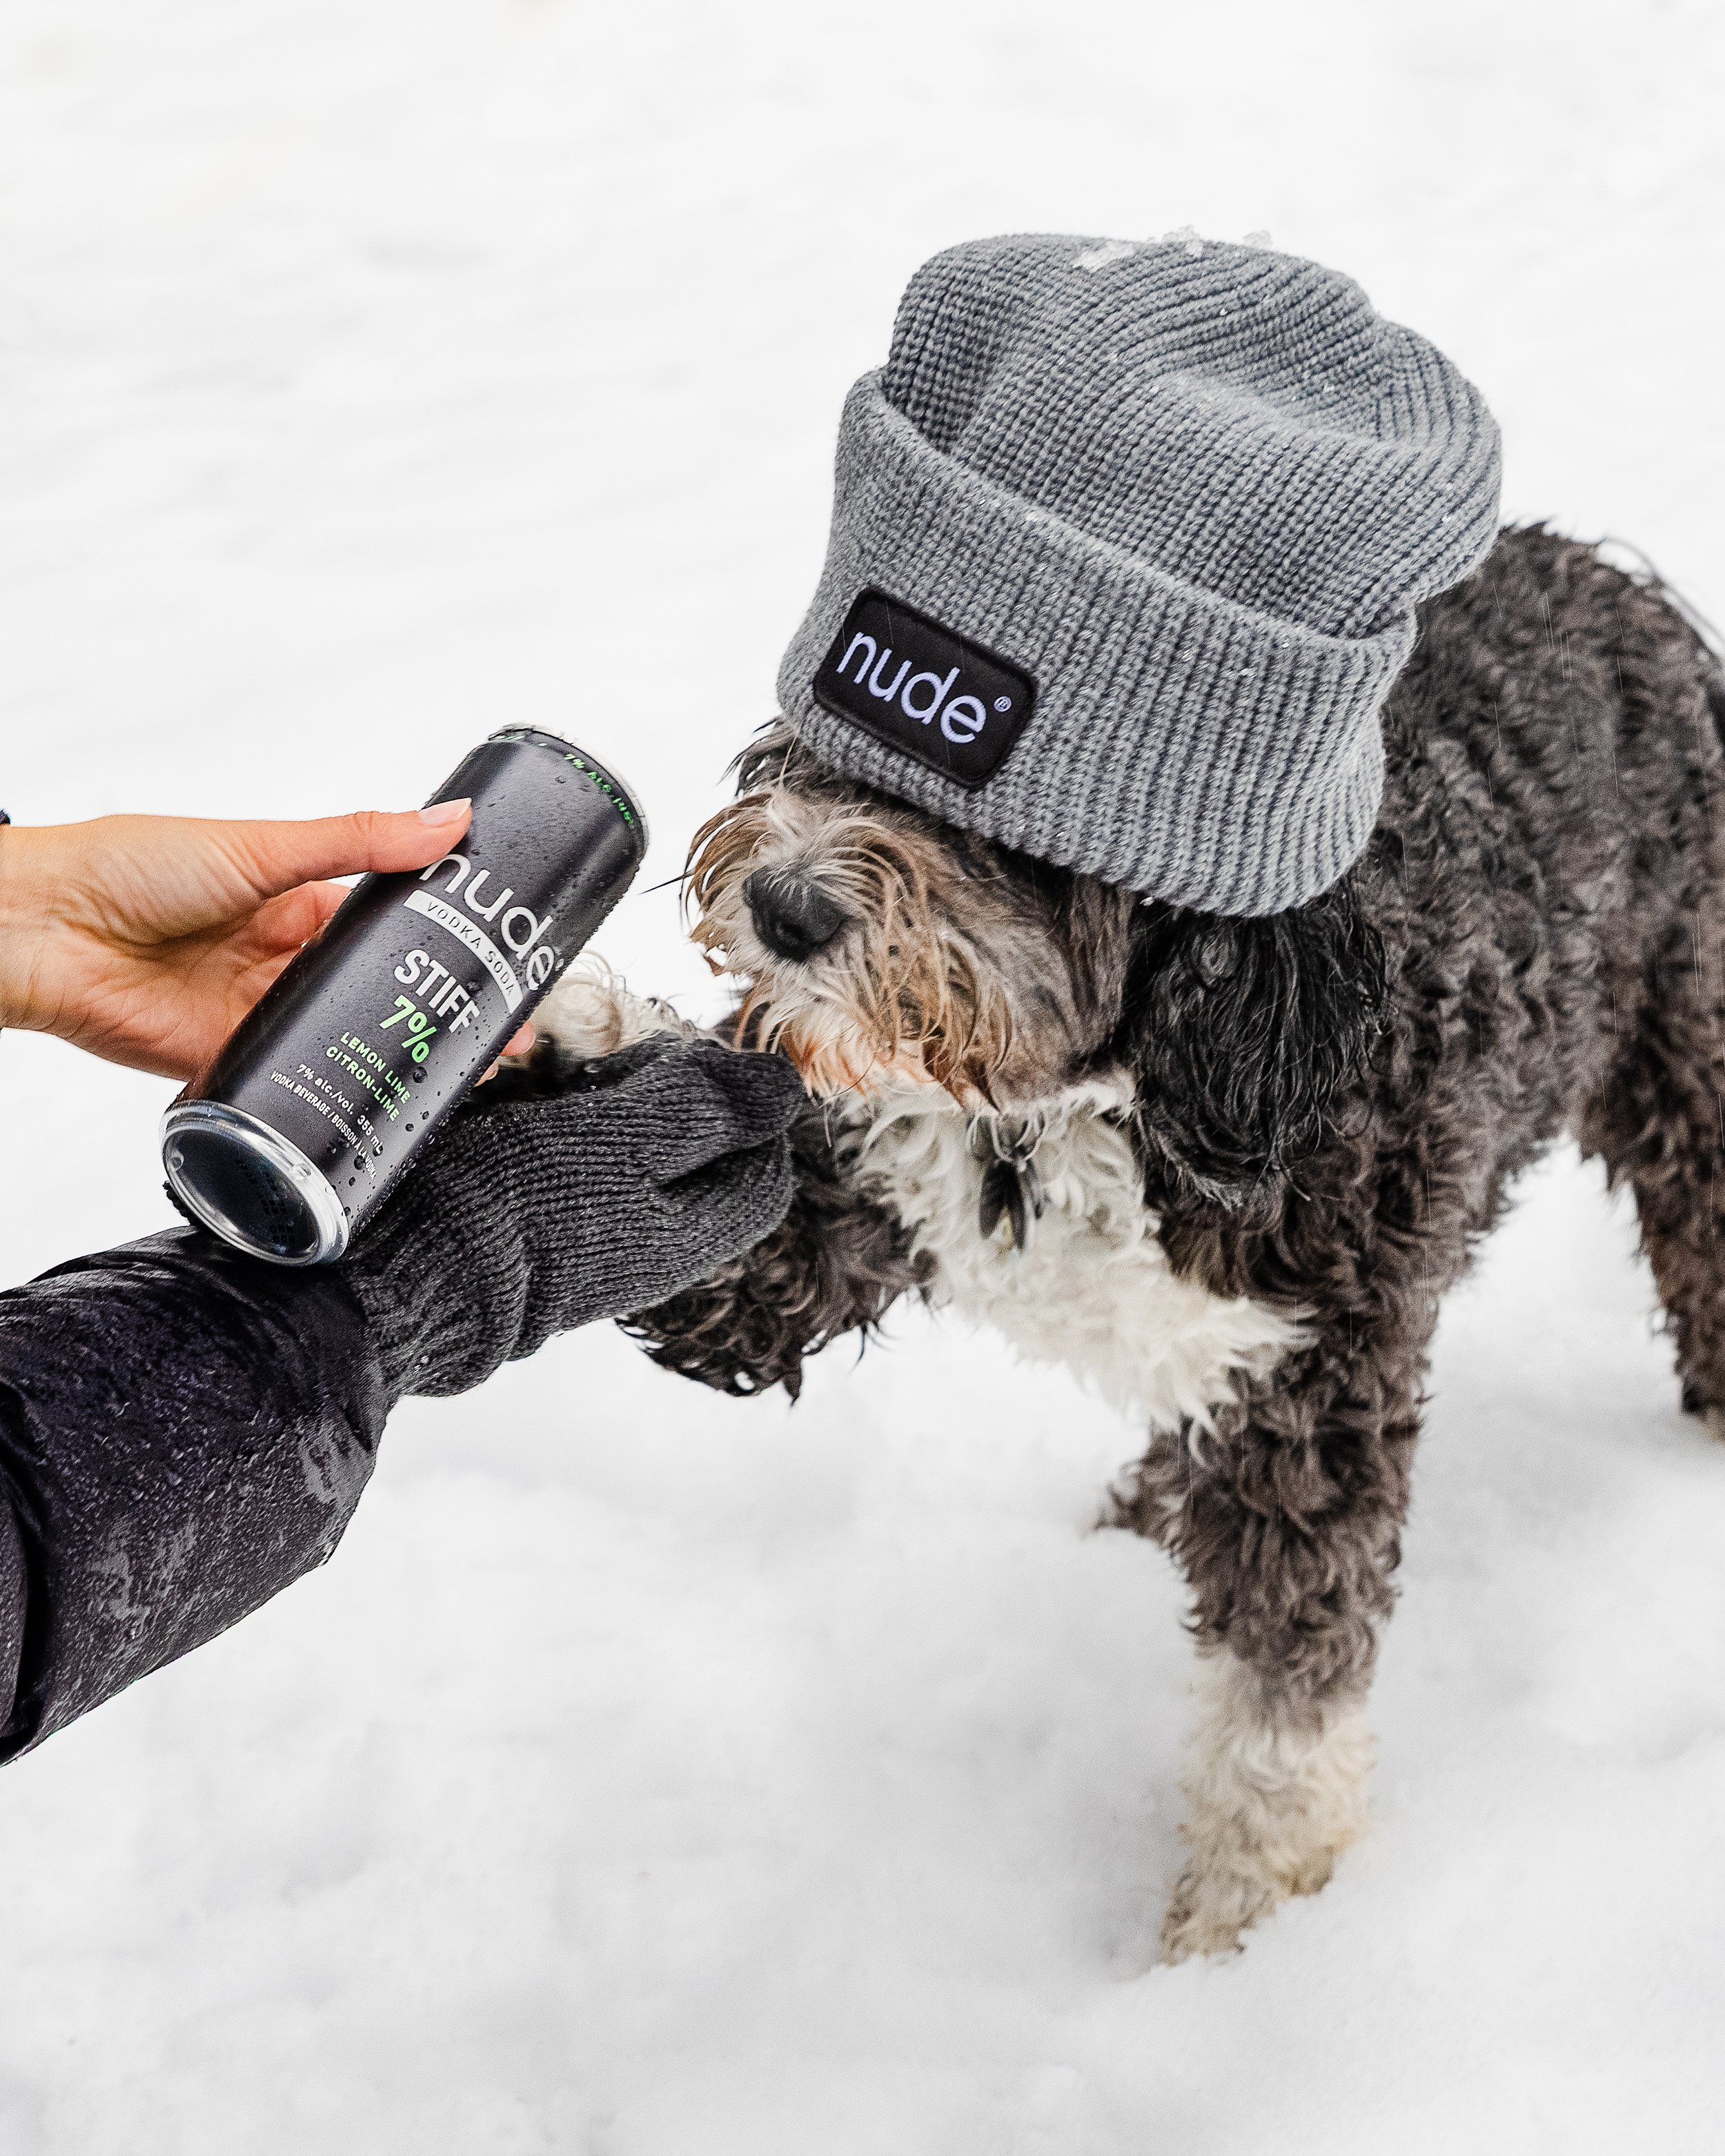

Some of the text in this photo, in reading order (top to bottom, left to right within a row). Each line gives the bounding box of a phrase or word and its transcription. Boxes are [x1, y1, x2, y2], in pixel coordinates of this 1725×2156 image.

[427, 901, 514, 996] VODKA SODA
[379, 994, 437, 1063] 7%
[394, 949, 480, 1033] STIFF
[296, 1064, 315, 1081] 7%
[357, 1115, 375, 1136] 355
[371, 1135, 383, 1155] mL
[326, 1046, 400, 1122] CITRON-LIME
[339, 1031, 411, 1105] LEMON LIME
[270, 1071, 296, 1090] VODKA
[293, 1084, 331, 1116] BEVERAGE
[331, 1114, 358, 1145] BOISSON
[357, 1146, 367, 1159] LA
[365, 1155, 377, 1180] VODKA
